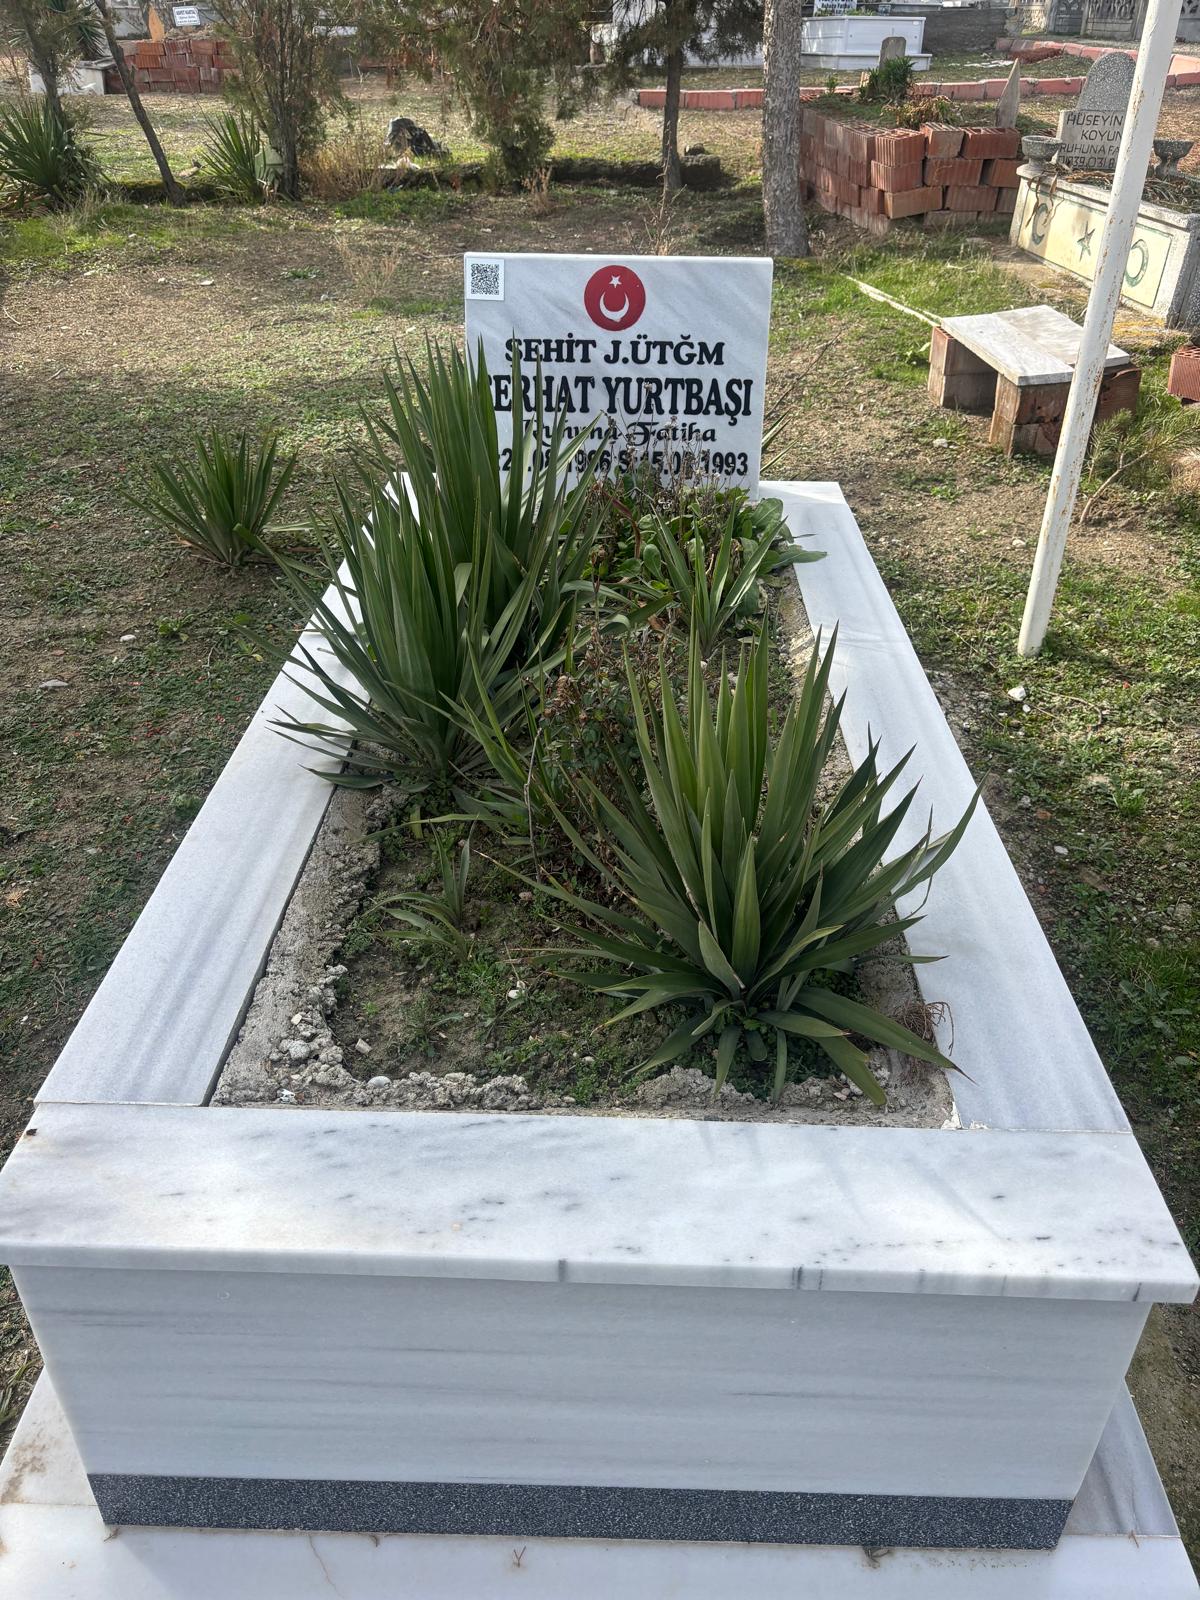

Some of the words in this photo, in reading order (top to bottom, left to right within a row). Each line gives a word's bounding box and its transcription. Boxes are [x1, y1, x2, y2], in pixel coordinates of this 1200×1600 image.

[1066, 111, 1124, 126] HÜSEYİN
[603, 333, 726, 366] J.ÜTĞM
[486, 374, 596, 413] ERHAT
[601, 376, 754, 426] YURTBAŞI
